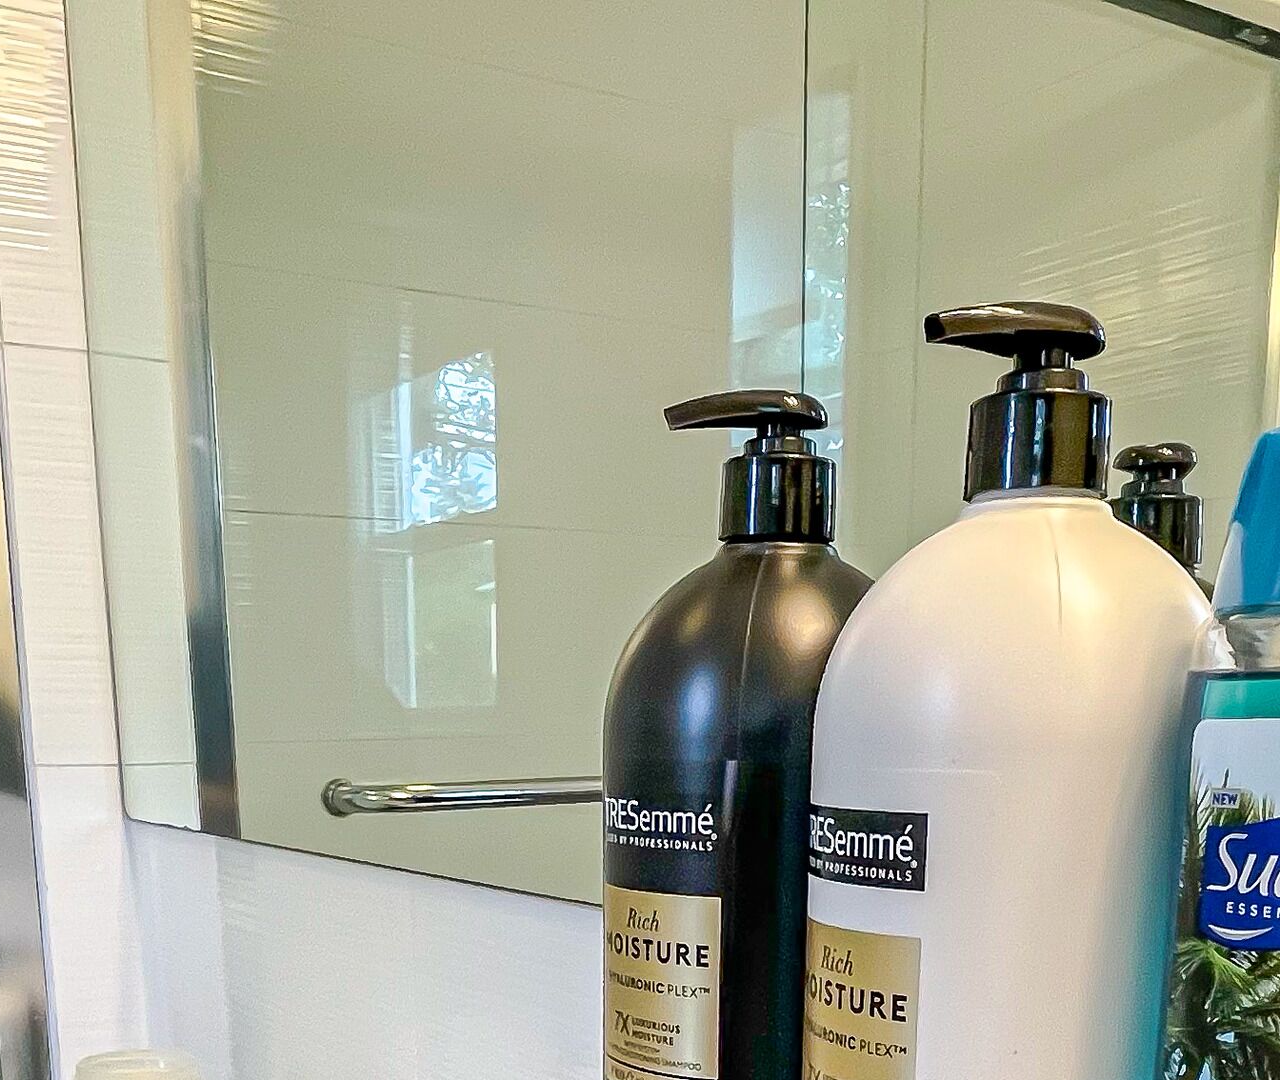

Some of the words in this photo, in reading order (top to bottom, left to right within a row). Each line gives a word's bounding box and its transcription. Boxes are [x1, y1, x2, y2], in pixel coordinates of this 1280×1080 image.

[1212, 793, 1238, 805] NEW
[629, 837, 713, 852] PROFESSIONALS
[809, 814, 914, 862] RESemmé
[825, 861, 913, 882] PROFESSIONALS
[626, 907, 659, 932] Rich
[821, 945, 853, 976] Rich
